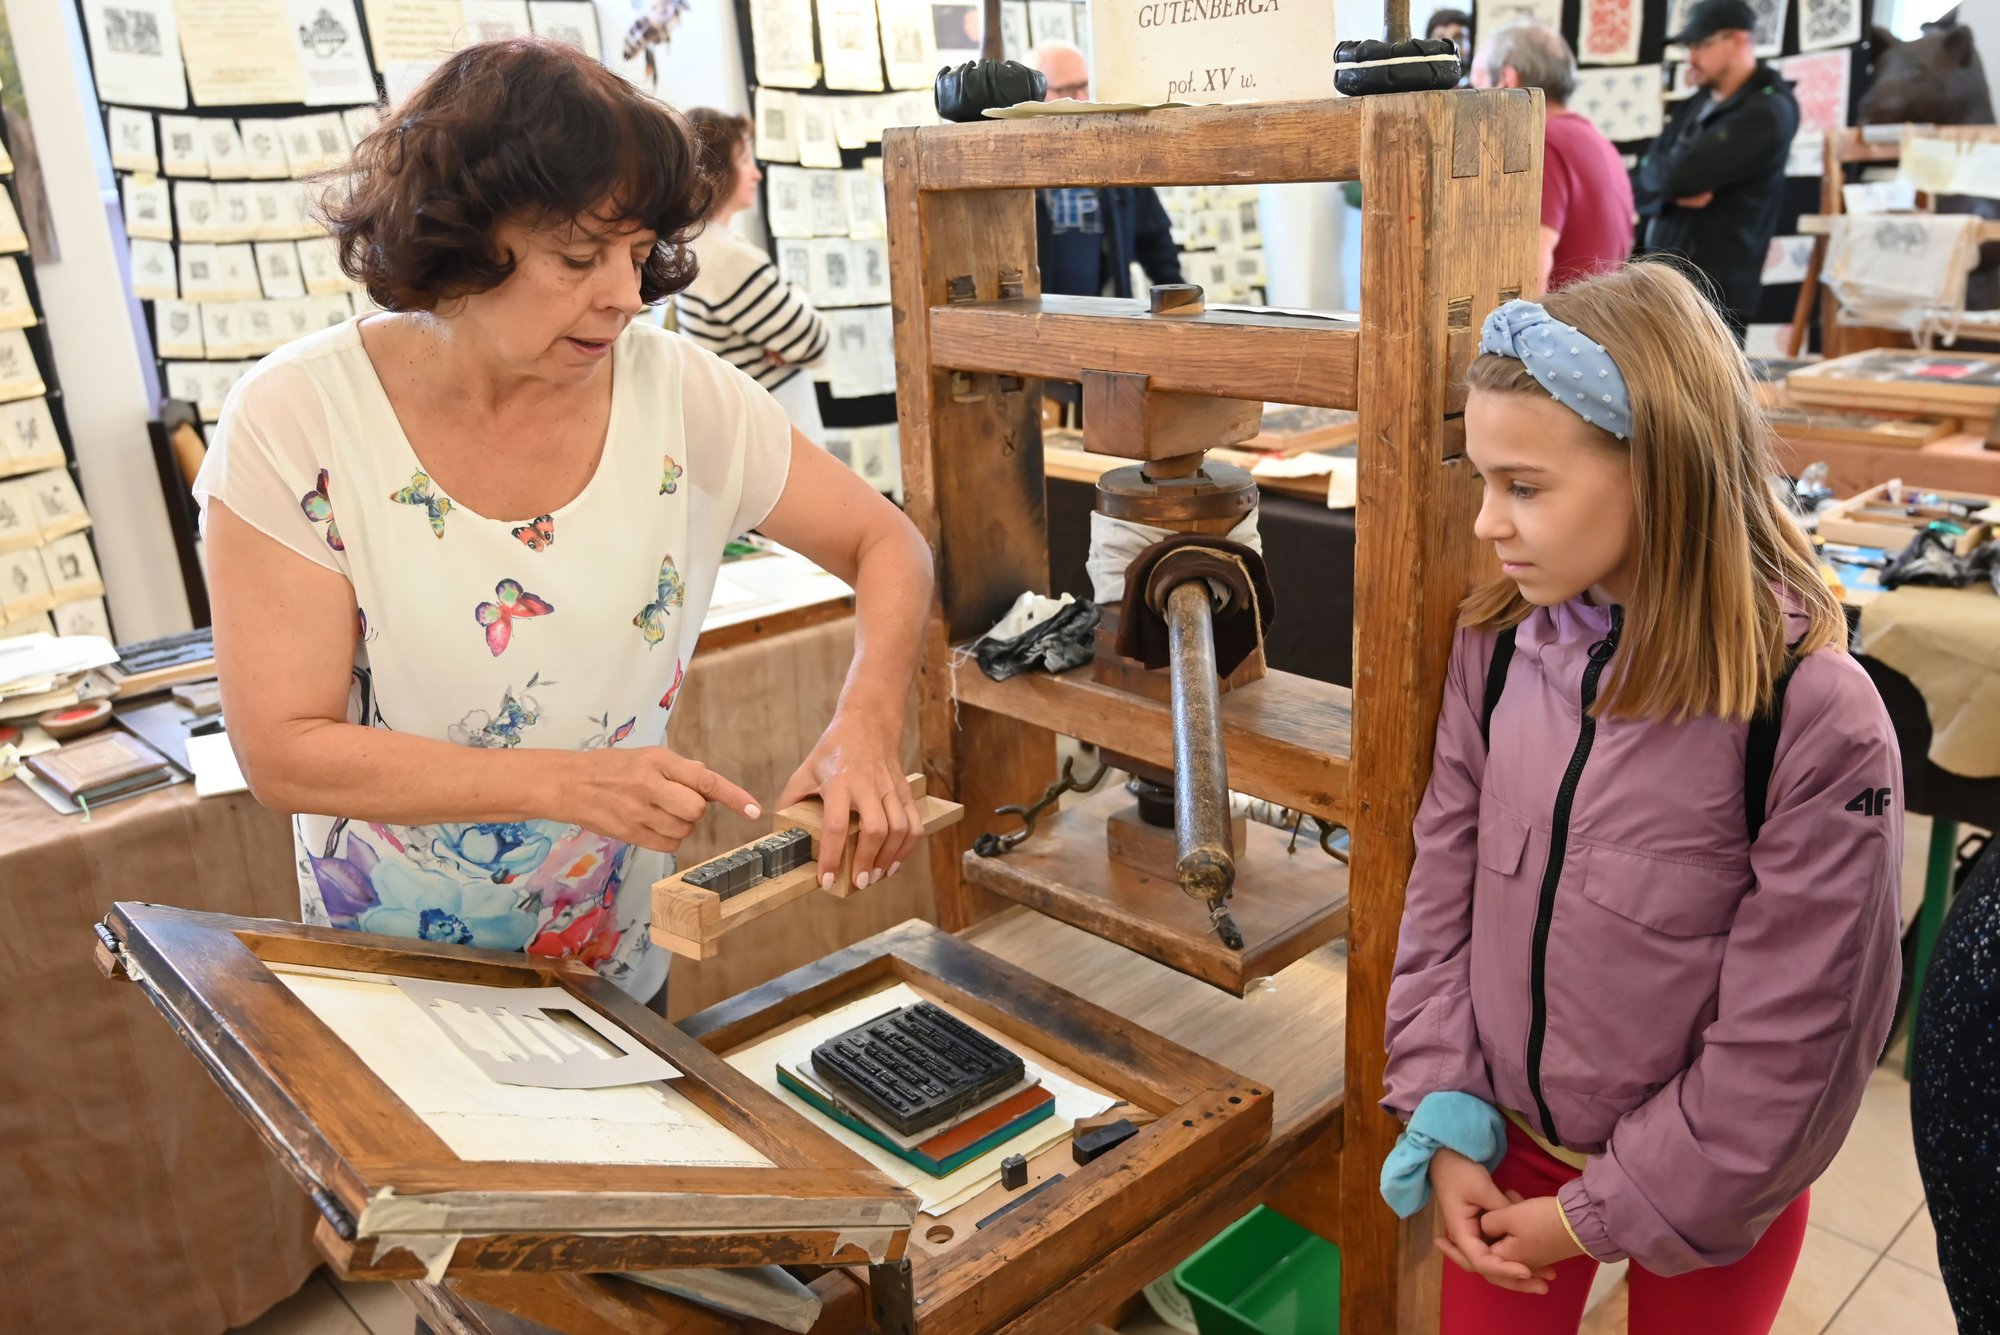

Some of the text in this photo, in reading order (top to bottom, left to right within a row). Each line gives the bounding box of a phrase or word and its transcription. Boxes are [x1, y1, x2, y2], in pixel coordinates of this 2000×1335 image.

[1167, 67, 1257, 102] poł. XV w.
[1844, 787, 1892, 817] 4F
